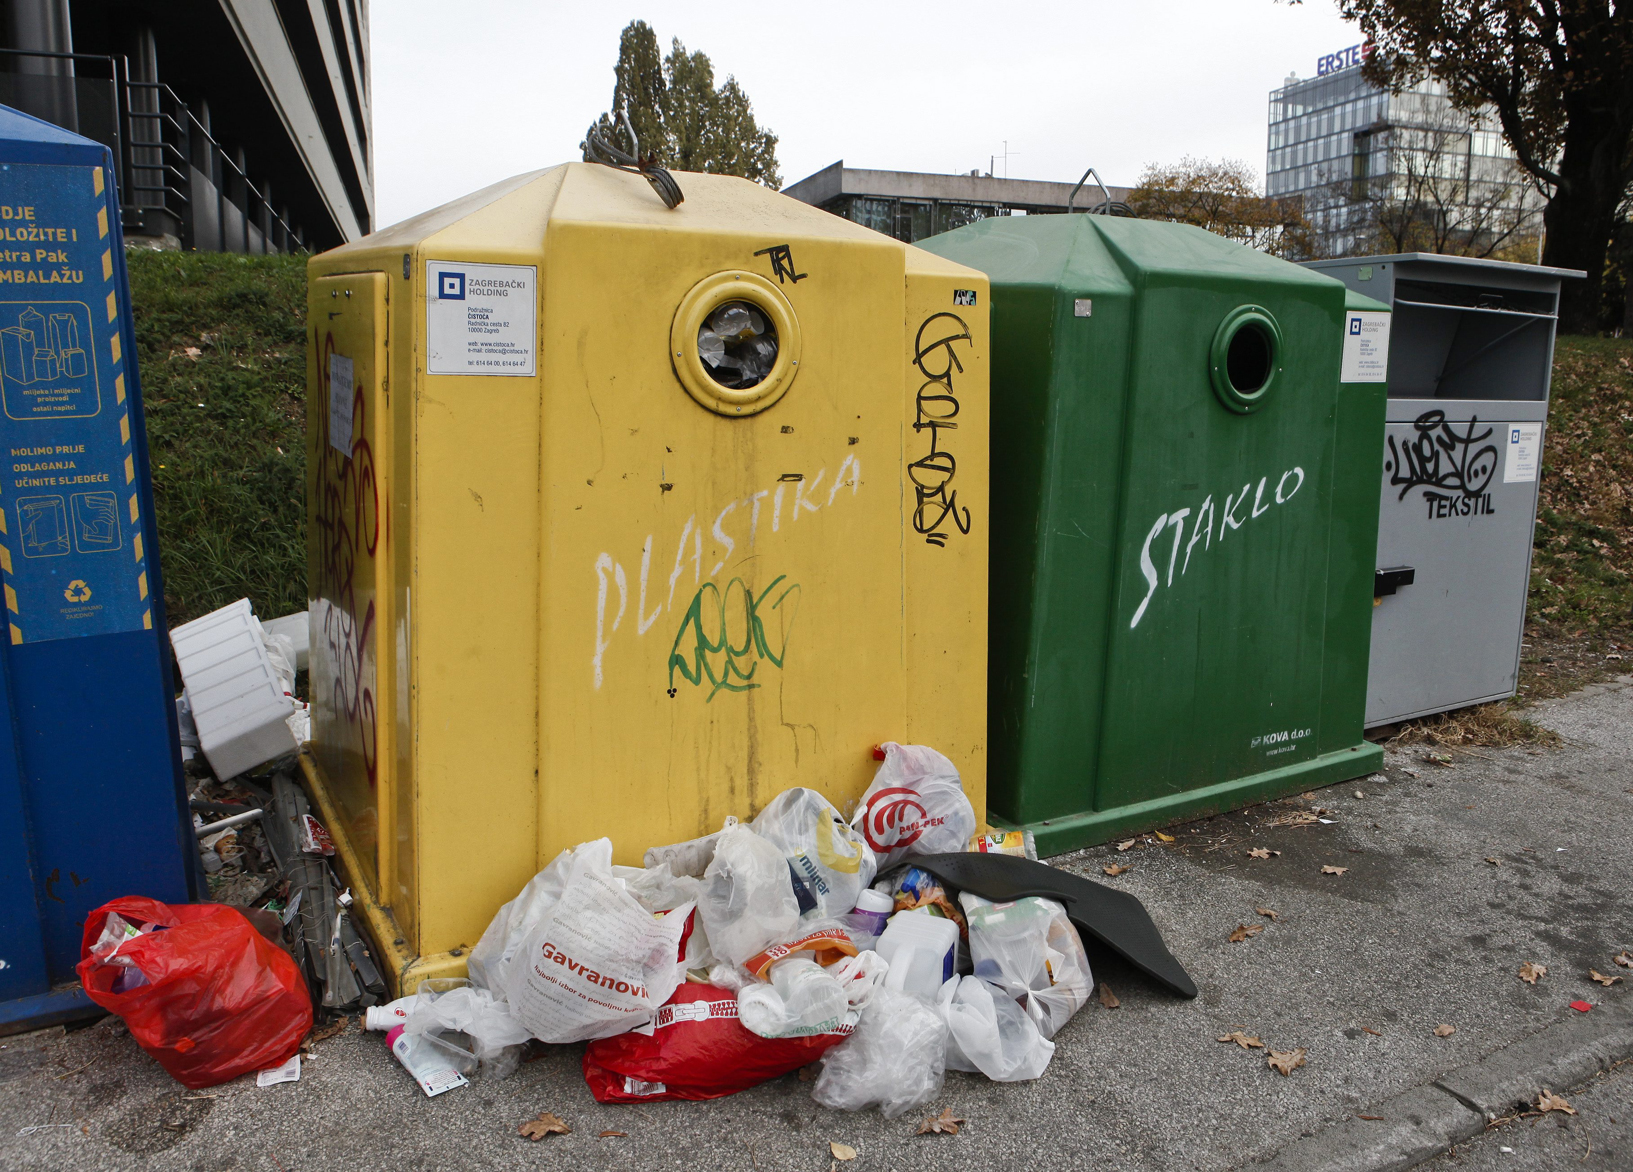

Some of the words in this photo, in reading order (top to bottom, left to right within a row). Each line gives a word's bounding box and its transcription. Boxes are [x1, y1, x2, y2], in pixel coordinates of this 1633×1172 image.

[1317, 44, 1361, 76] ERSTE
[71, 228, 78, 242] I
[35, 249, 69, 263] Pak
[468, 279, 526, 289] ZAGREBAČKI
[468, 288, 509, 297] HOLDING
[11, 446, 53, 457] MOLIMO
[55, 444, 85, 454] PRIJE
[13, 461, 76, 472] ODLAGANJA
[15, 476, 57, 488] UČINITE
[1426, 493, 1495, 519] TEKSTIL
[1130, 466, 1305, 629] STAKLO
[592, 453, 860, 691] PLASTIKA
[1262, 730, 1289, 745] KOVA
[899, 816, 945, 836] PAN-PEK
[583, 872, 618, 897] Gavranović
[799, 855, 830, 896] mlinar
[553, 917, 592, 943] Gavranović
[558, 980, 577, 994] izbor
[578, 992, 587, 1000] za
[588, 997, 622, 1012] povoljnu
